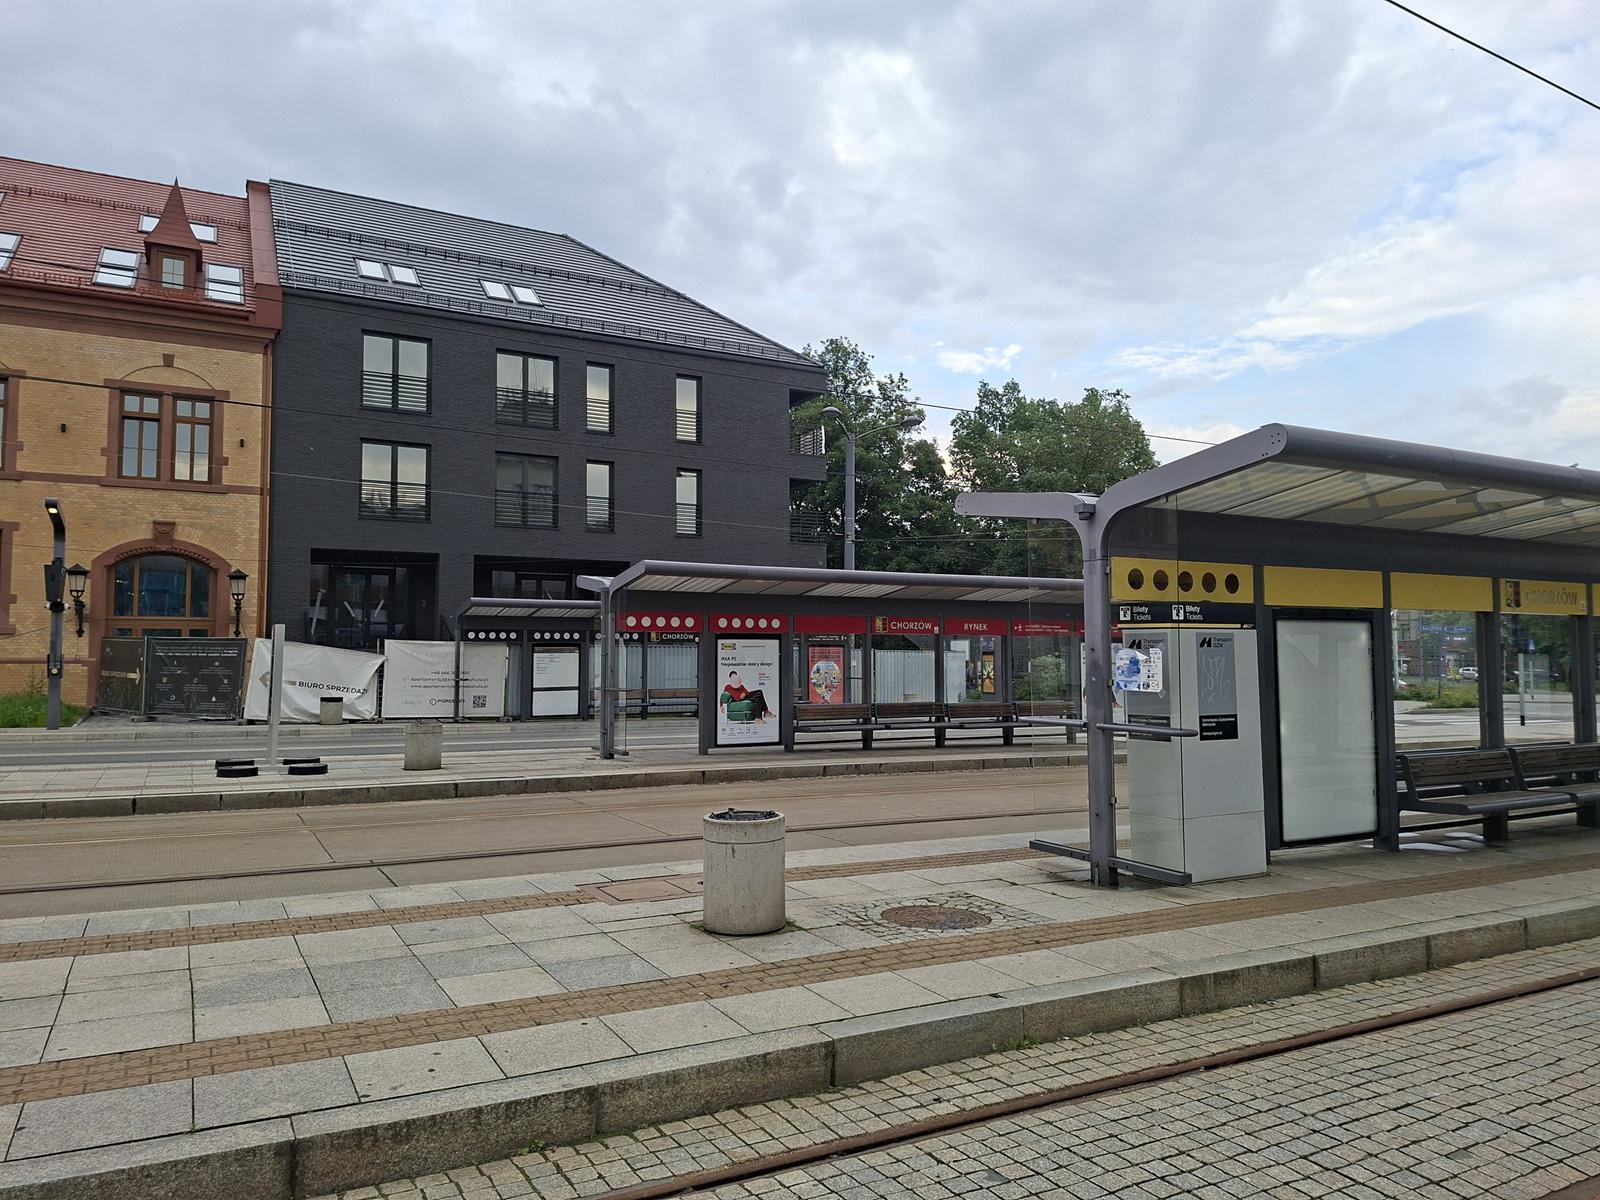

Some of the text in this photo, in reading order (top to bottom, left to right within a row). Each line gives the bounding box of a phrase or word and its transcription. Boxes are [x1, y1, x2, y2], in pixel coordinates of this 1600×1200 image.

[1526, 588, 1578, 604] CHORZÓW
[1133, 606, 1148, 614] Bilety
[1186, 605, 1200, 613] Bilety
[890, 620, 932, 630] CHORZÓW
[298, 681, 324, 689] BIURO
